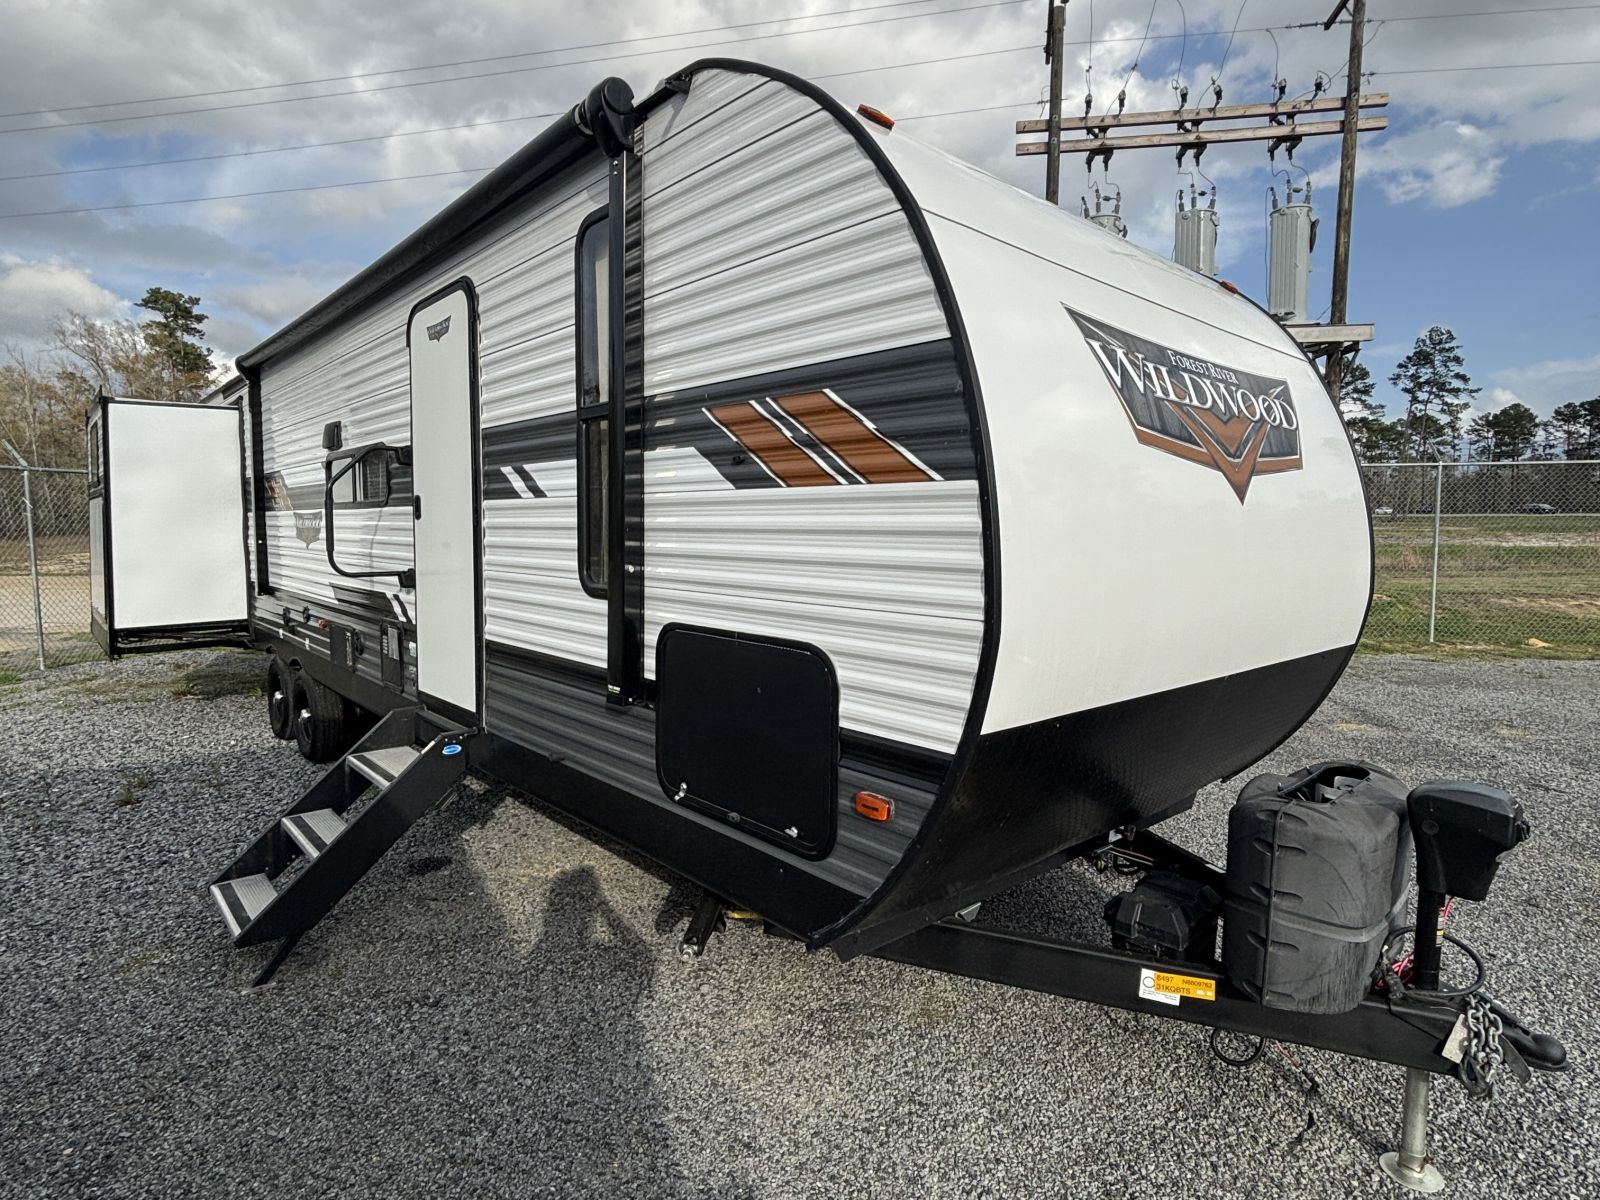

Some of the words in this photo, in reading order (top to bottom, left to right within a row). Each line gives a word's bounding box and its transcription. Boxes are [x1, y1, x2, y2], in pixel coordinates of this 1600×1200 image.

[1084, 337, 1298, 430] WILDWOOD
[1167, 349, 1209, 375] FOREST
[1207, 362, 1239, 385] RIVER
